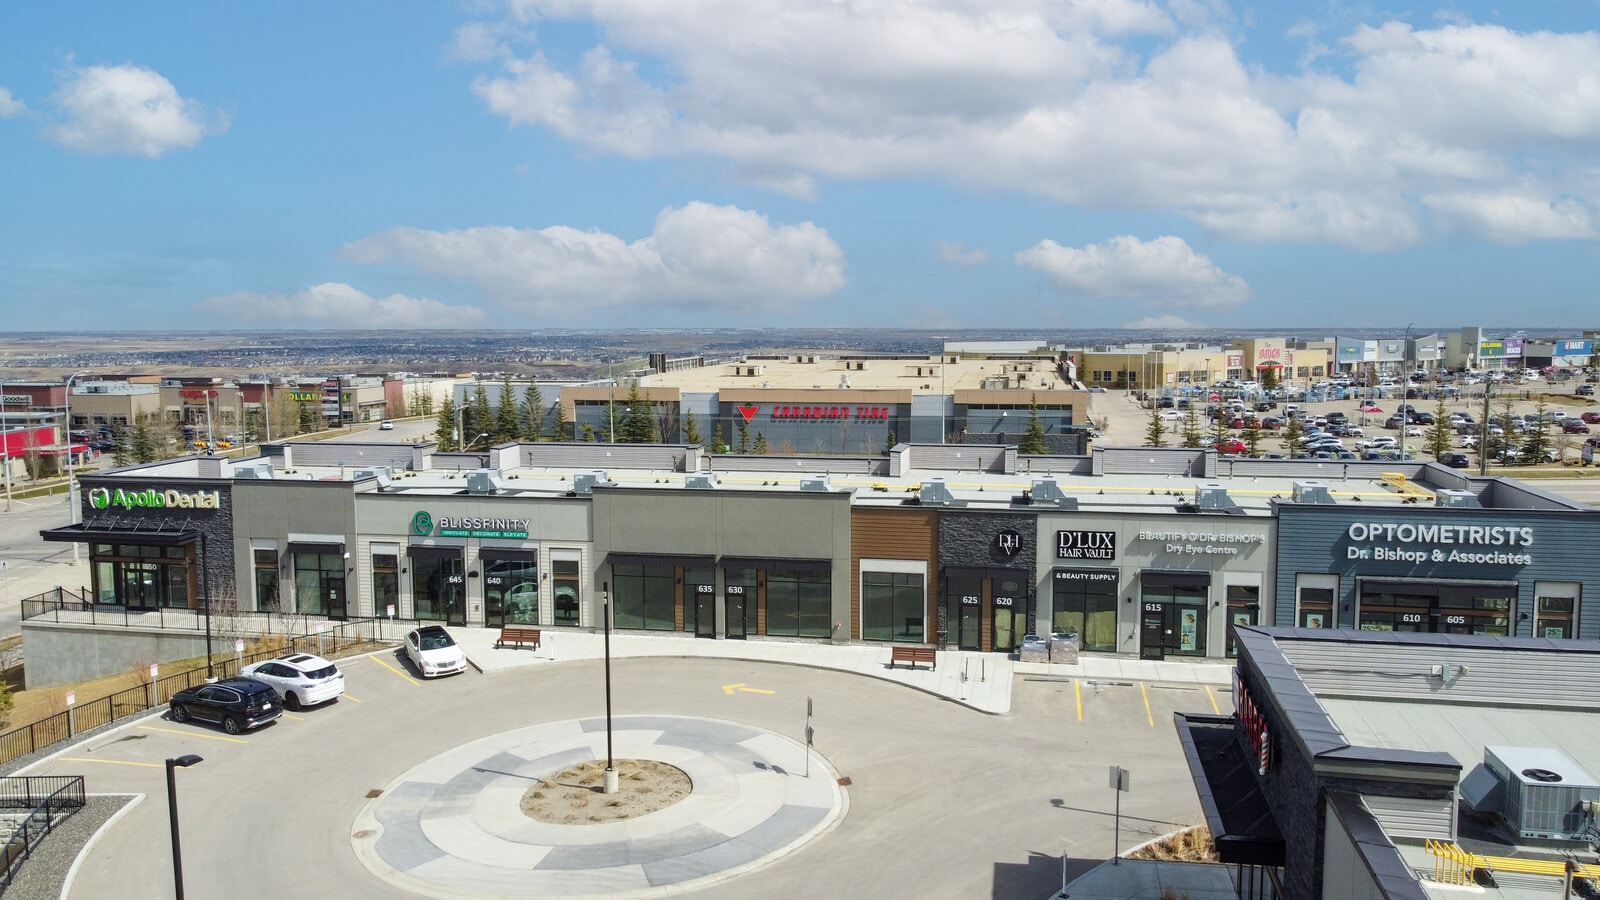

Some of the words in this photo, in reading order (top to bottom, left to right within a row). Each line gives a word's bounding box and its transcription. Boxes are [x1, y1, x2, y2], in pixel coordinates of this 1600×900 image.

[773, 406, 850, 418] CANADIAN
[857, 407, 889, 419] TIRE
[440, 517, 531, 530] BLISSFINITY
[1139, 531, 1187, 541] BEAUTIFY
[1349, 522, 1534, 546] OPTOMETRISTS
[1059, 531, 1114, 549] D'LUX
[1059, 548, 1083, 558] HAIR
[1084, 549, 1114, 559] VAULT
[1166, 544, 1183, 554] Dry
[1186, 544, 1203, 555] Eye
[1205, 545, 1238, 555] Centre
[1347, 546, 1369, 559] Dr.
[1374, 547, 1426, 564] Bishop
[1431, 549, 1444, 562] &
[1447, 550, 1532, 565] Associates
[698, 585, 713, 593] 635
[962, 596, 978, 604] 625
[996, 597, 1012, 605] 620
[1145, 603, 1162, 612] 615
[1403, 614, 1421, 622] 610
[1447, 615, 1465, 624] 605
